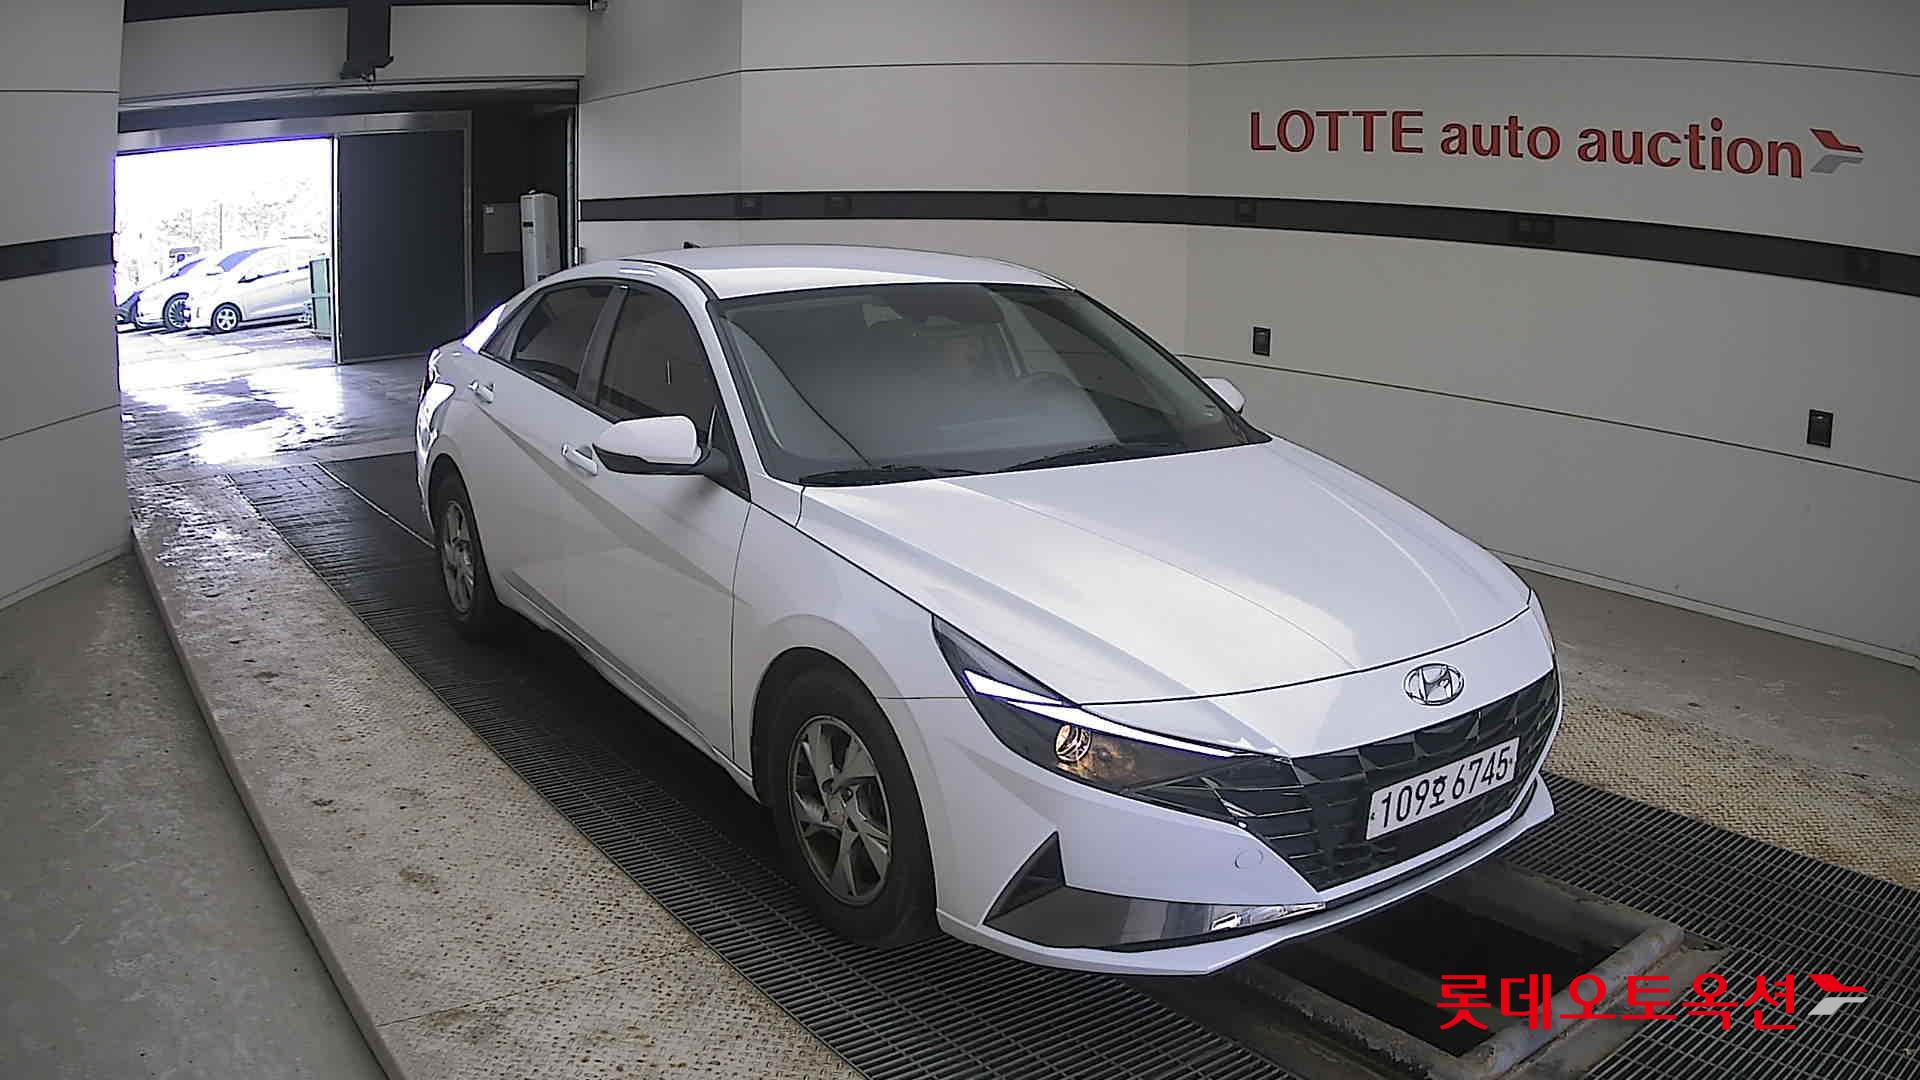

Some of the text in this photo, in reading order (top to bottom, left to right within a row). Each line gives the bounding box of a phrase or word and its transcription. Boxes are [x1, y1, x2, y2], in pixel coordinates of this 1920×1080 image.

[1250, 109, 1803, 179] LOTTE auto auction
